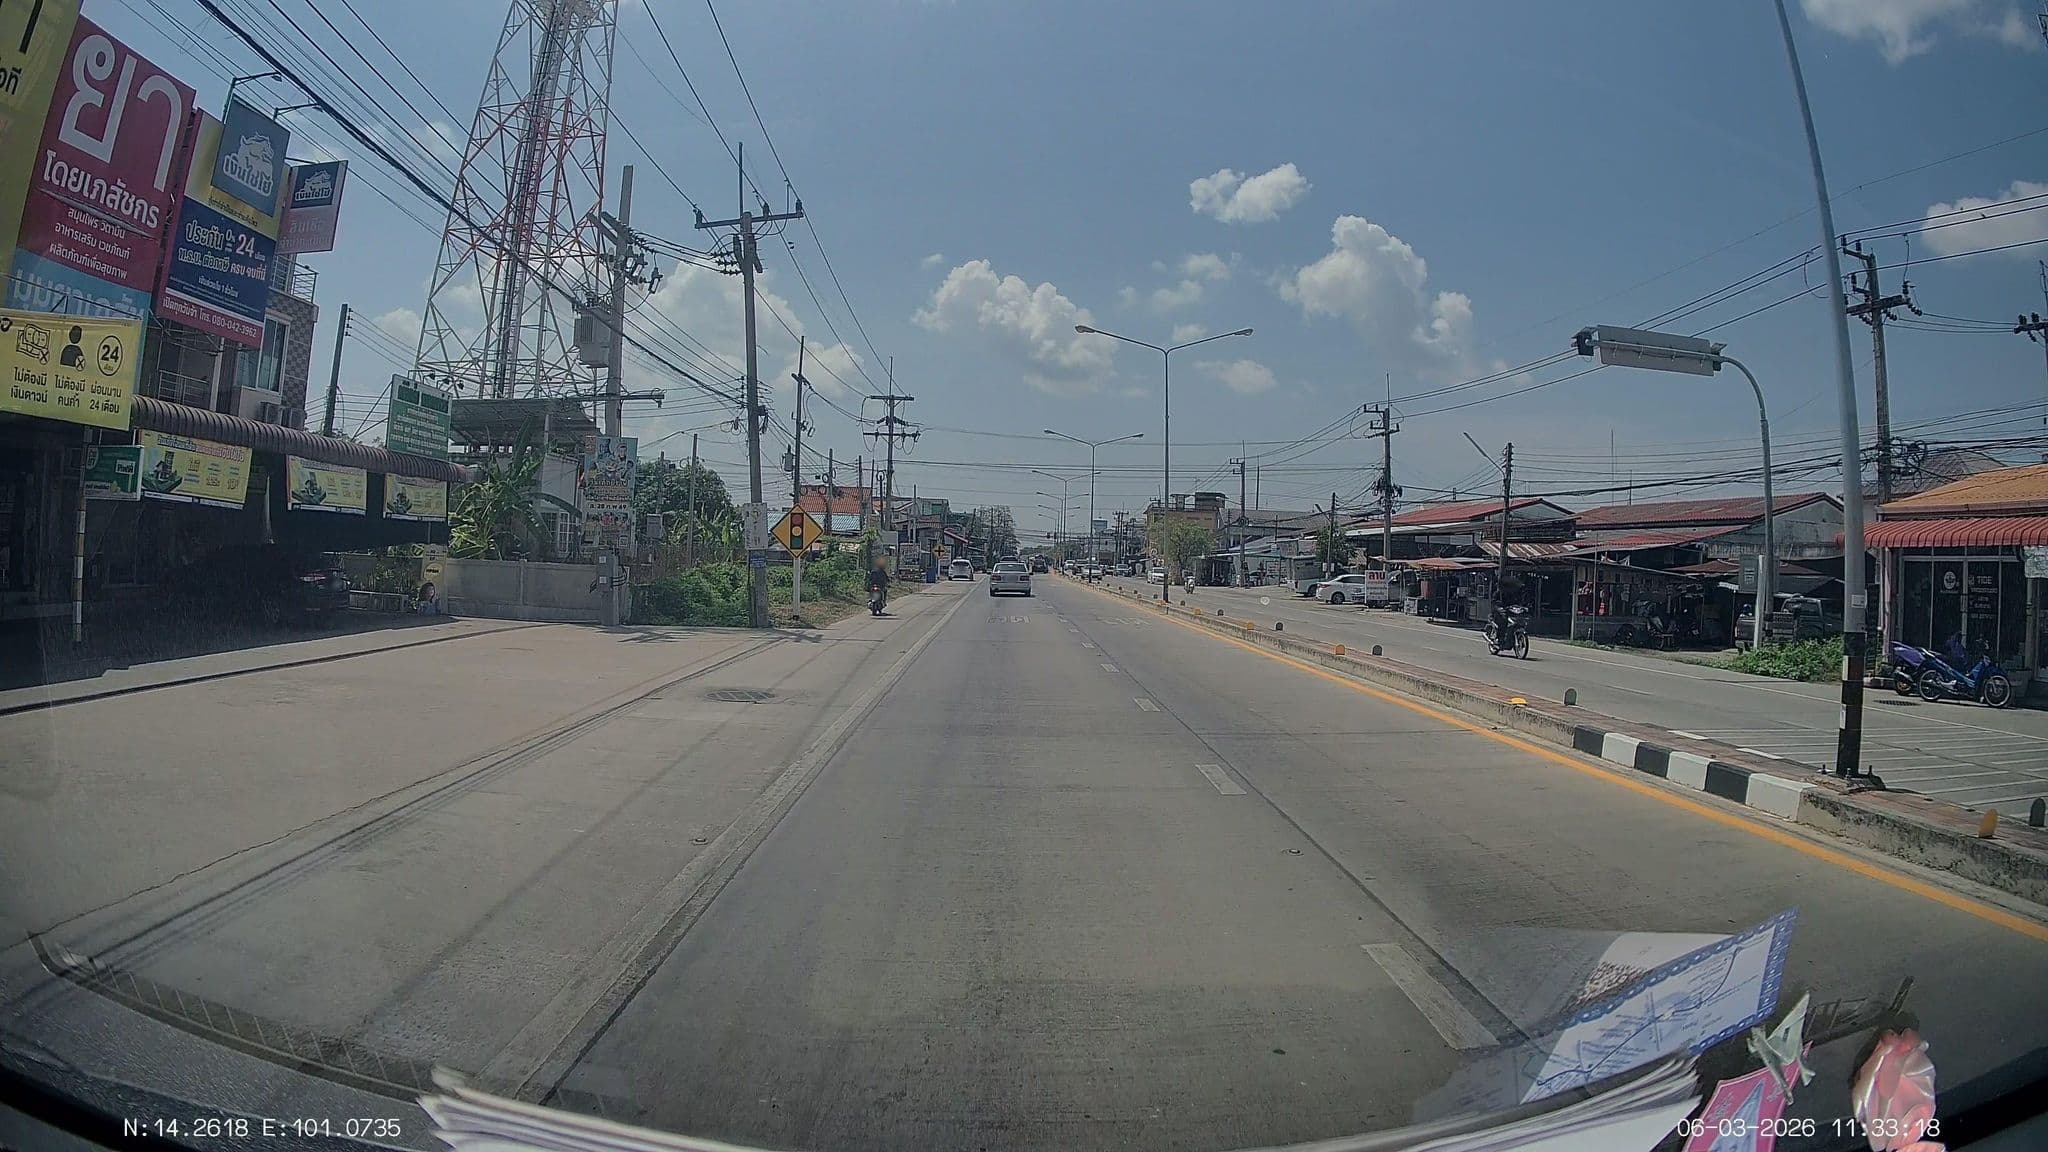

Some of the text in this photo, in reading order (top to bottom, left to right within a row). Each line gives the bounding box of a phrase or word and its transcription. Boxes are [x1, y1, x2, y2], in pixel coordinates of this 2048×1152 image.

[58, 34, 182, 192] ยา
[43, 149, 160, 229] โดยเภสัชกร
[67, 208, 99, 229] สมุนไพร
[54, 222, 131, 260] อาหารเสริม เวชภัณฑ์
[185, 220, 225, 250] ประกัน
[235, 234, 256, 258] 24
[49, 243, 128, 280] ผลิตภัณฑ์เพื่อสุขภาพ
[202, 251, 230, 273] ต่อภาษี
[101, 344, 120, 363] 24
[13, 366, 48, 387] ไม่ต้องมี
[54, 374, 86, 393] ไม่ต้องมี
[10, 385, 48, 404] เงินดาวน์
[57, 392, 81, 408] คนค้ำ
[90, 381, 122, 398] ผ่อนนาน
[89, 399, 120, 414] 24 เดือน
